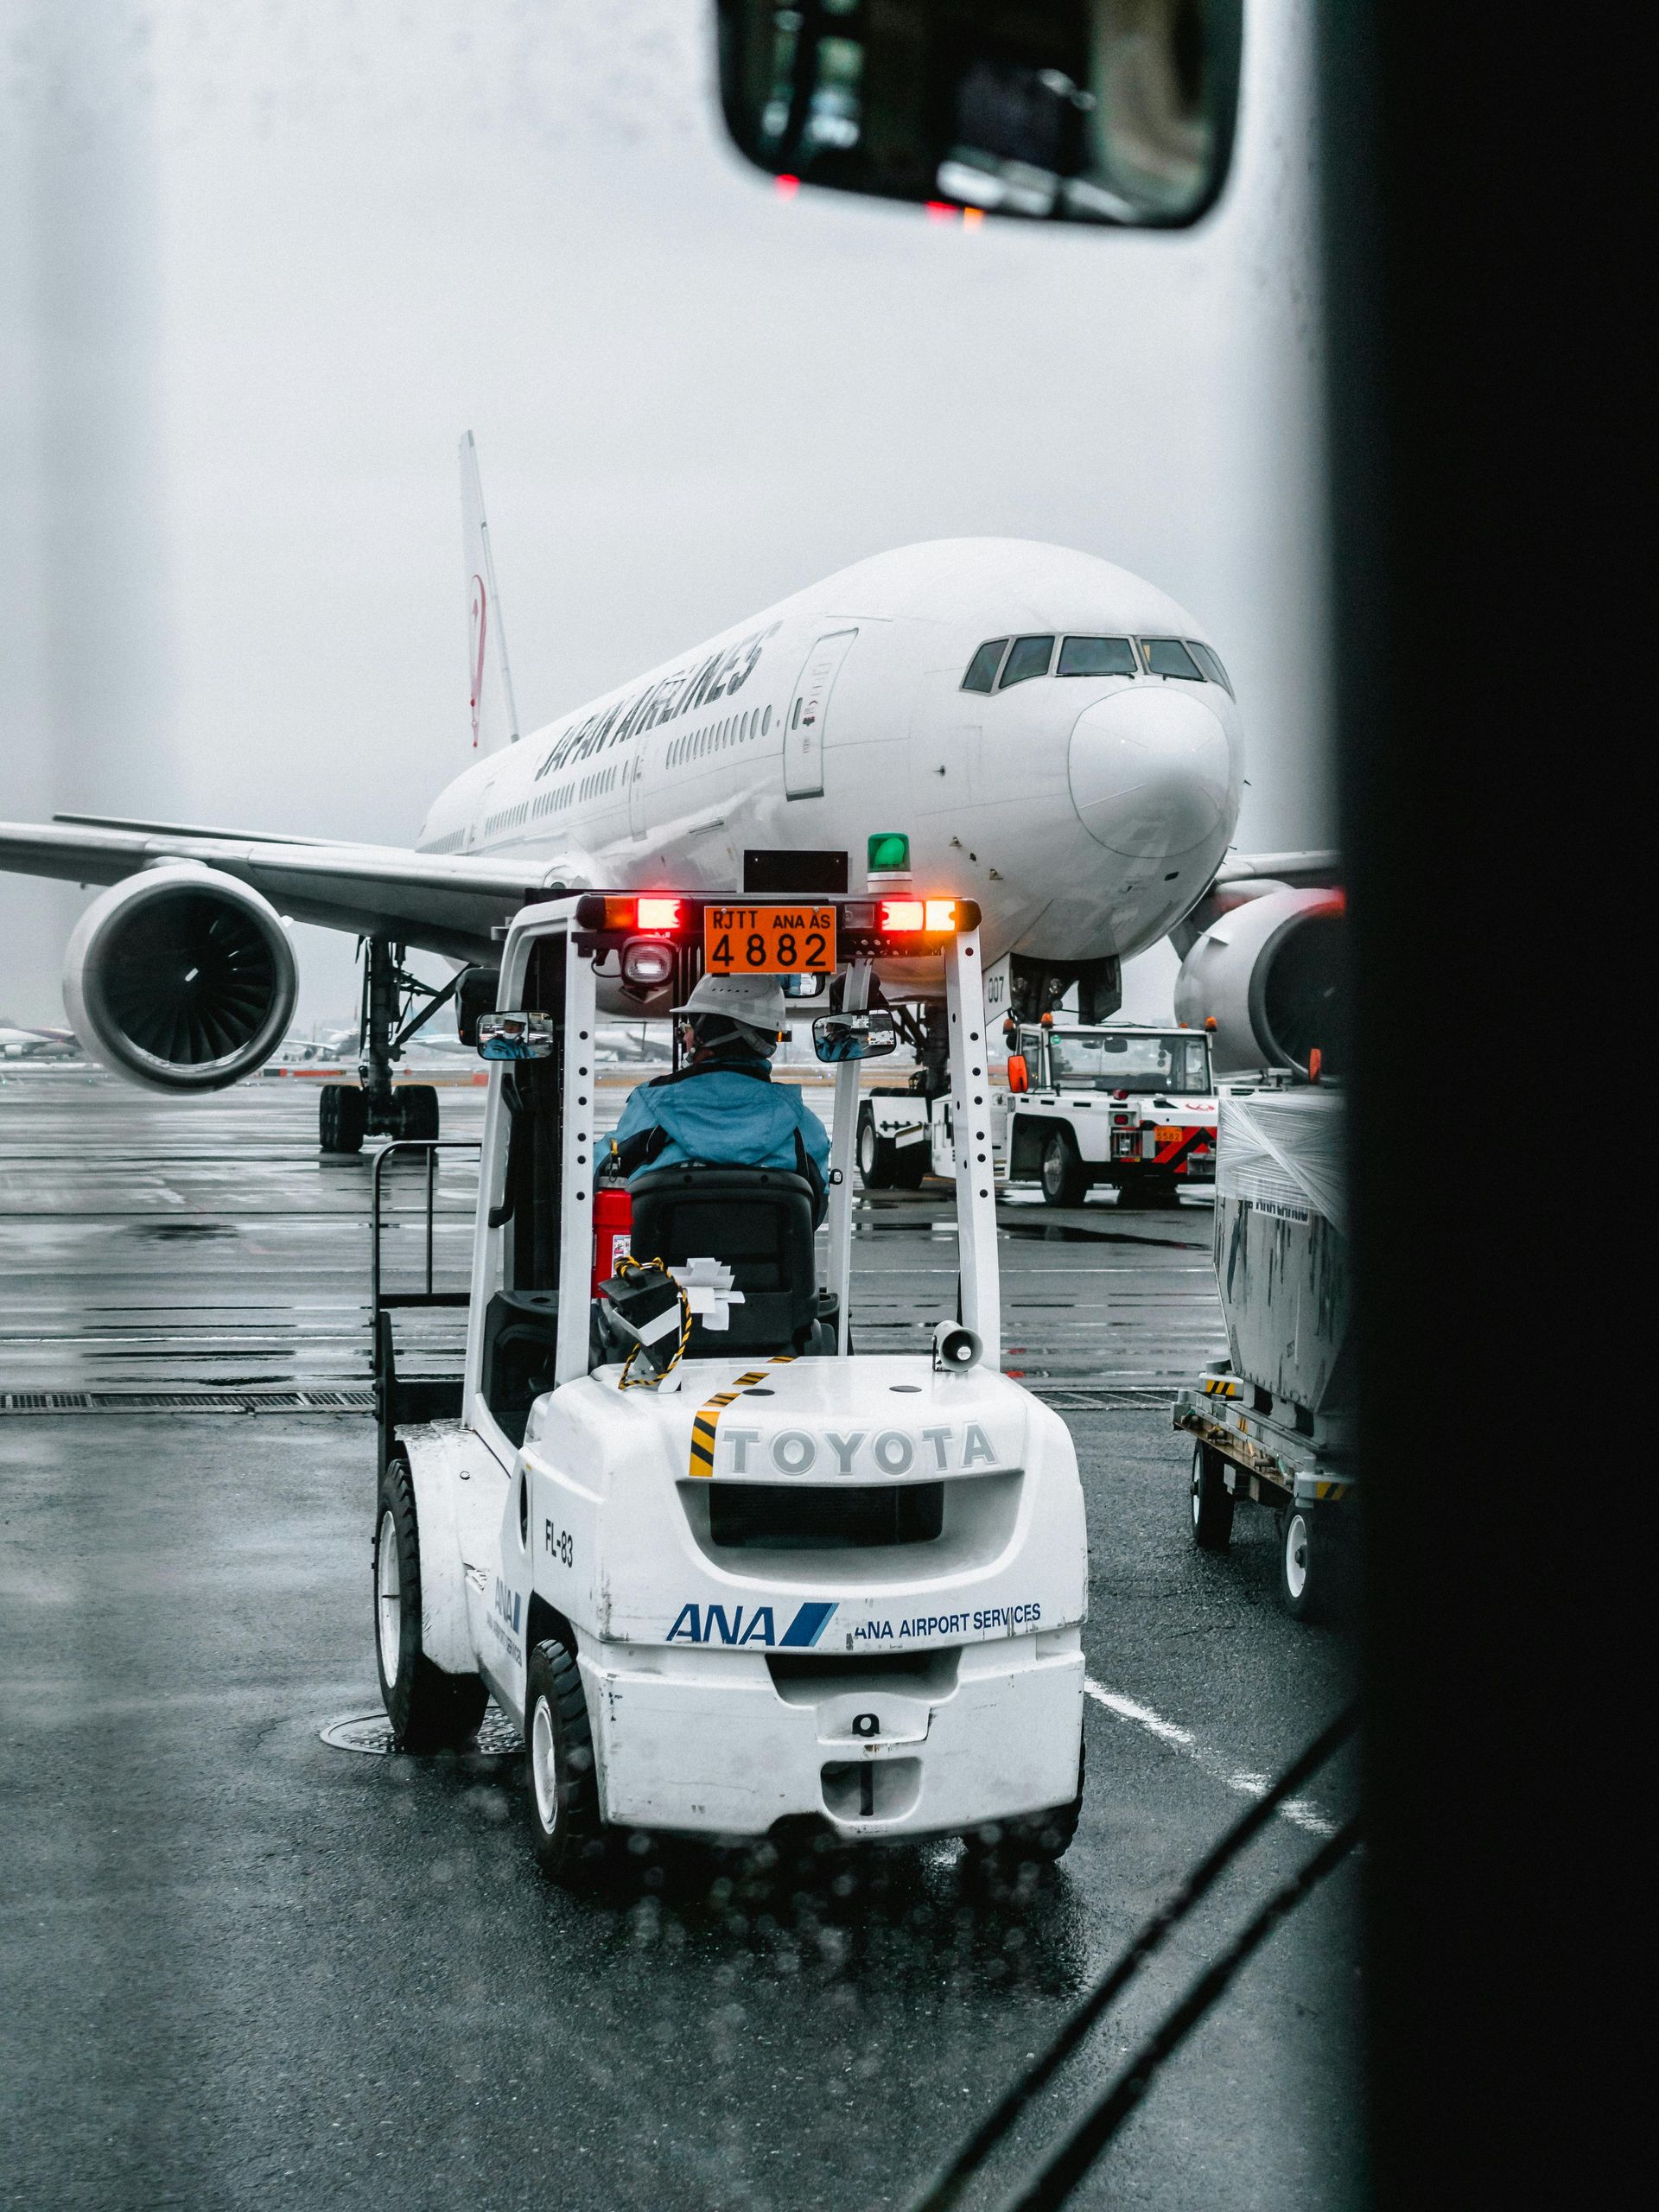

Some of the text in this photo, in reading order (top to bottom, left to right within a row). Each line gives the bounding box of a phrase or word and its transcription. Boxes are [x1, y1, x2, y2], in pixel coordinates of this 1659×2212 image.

[534, 620, 783, 781] JAPAN AIRLINES
[713, 910, 831, 930] RJTT ANA AS
[712, 933, 827, 967] 4882
[988, 976, 1005, 1003] 007
[722, 1421, 999, 1474] TOYOTA
[545, 1518, 573, 1568] FL-83
[495, 1576, 514, 1630] ANA
[665, 1603, 776, 1647] ANA
[899, 1612, 970, 1639] AIRPORT
[973, 1602, 1042, 1630] SERVICES
